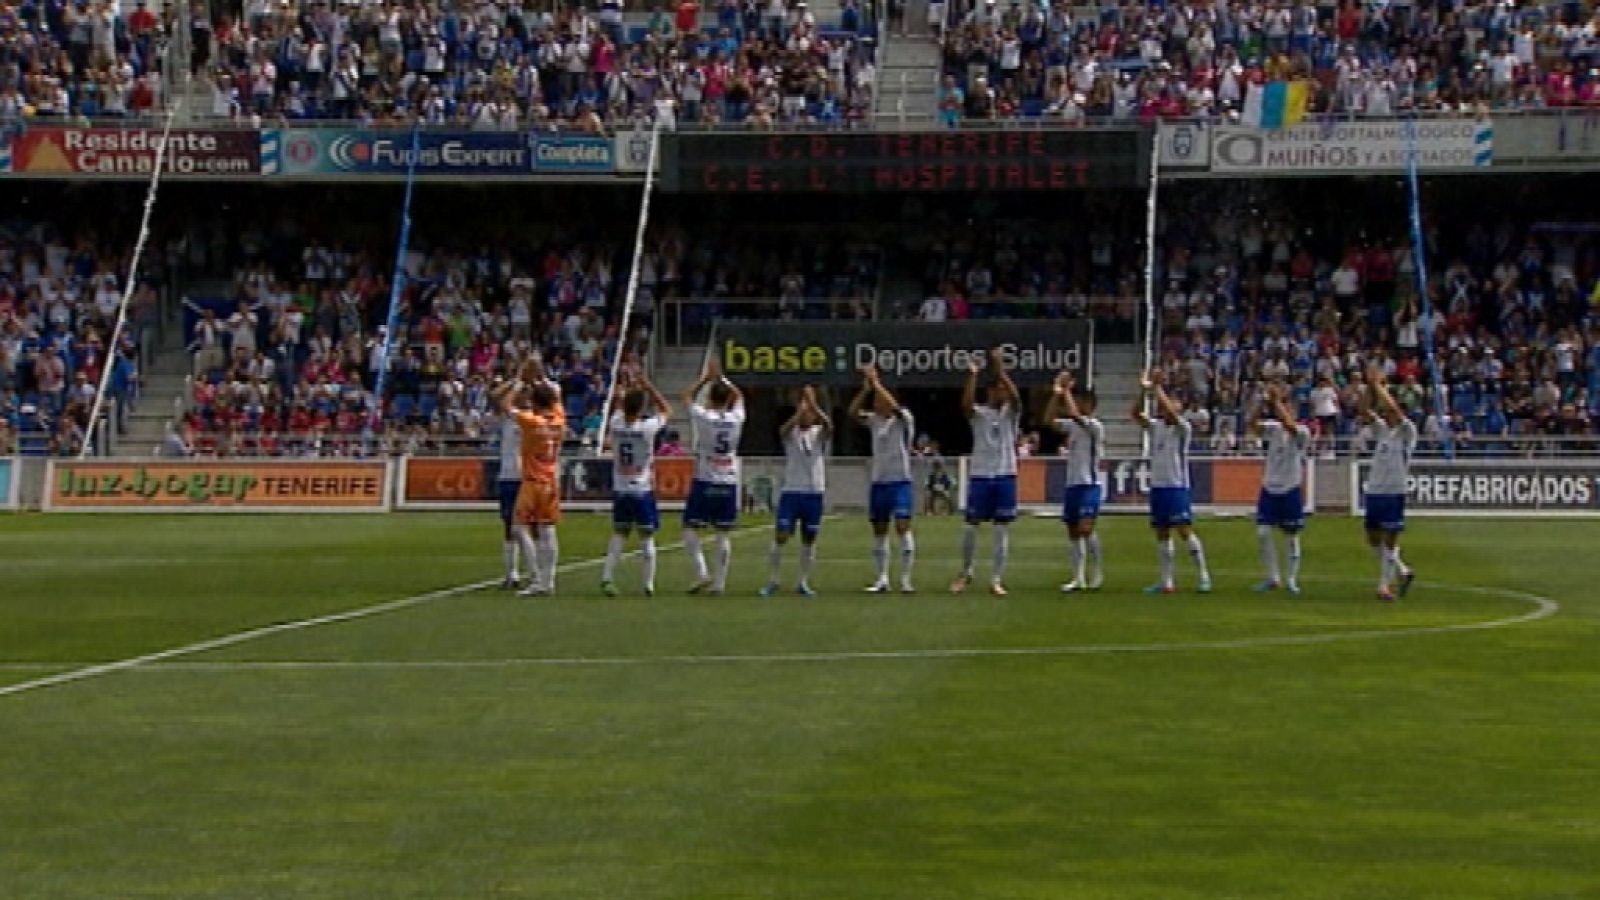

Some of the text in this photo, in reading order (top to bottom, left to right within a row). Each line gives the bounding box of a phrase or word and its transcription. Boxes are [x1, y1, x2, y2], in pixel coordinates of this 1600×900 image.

[64, 130, 217, 151] Residente
[768, 133, 1046, 159] C.D. TENERIFE
[1267, 144, 1359, 167] MUIÑOS
[704, 166, 781, 191] C.E.
[875, 161, 1091, 188] HOSPITALET
[725, 340, 827, 371] base
[854, 343, 987, 375] Deportes
[1000, 342, 1081, 370] Salud
[715, 432, 730, 453] 5
[264, 477, 377, 496] TENERIFE
[1405, 474, 1591, 504] PREFABRICADOS
